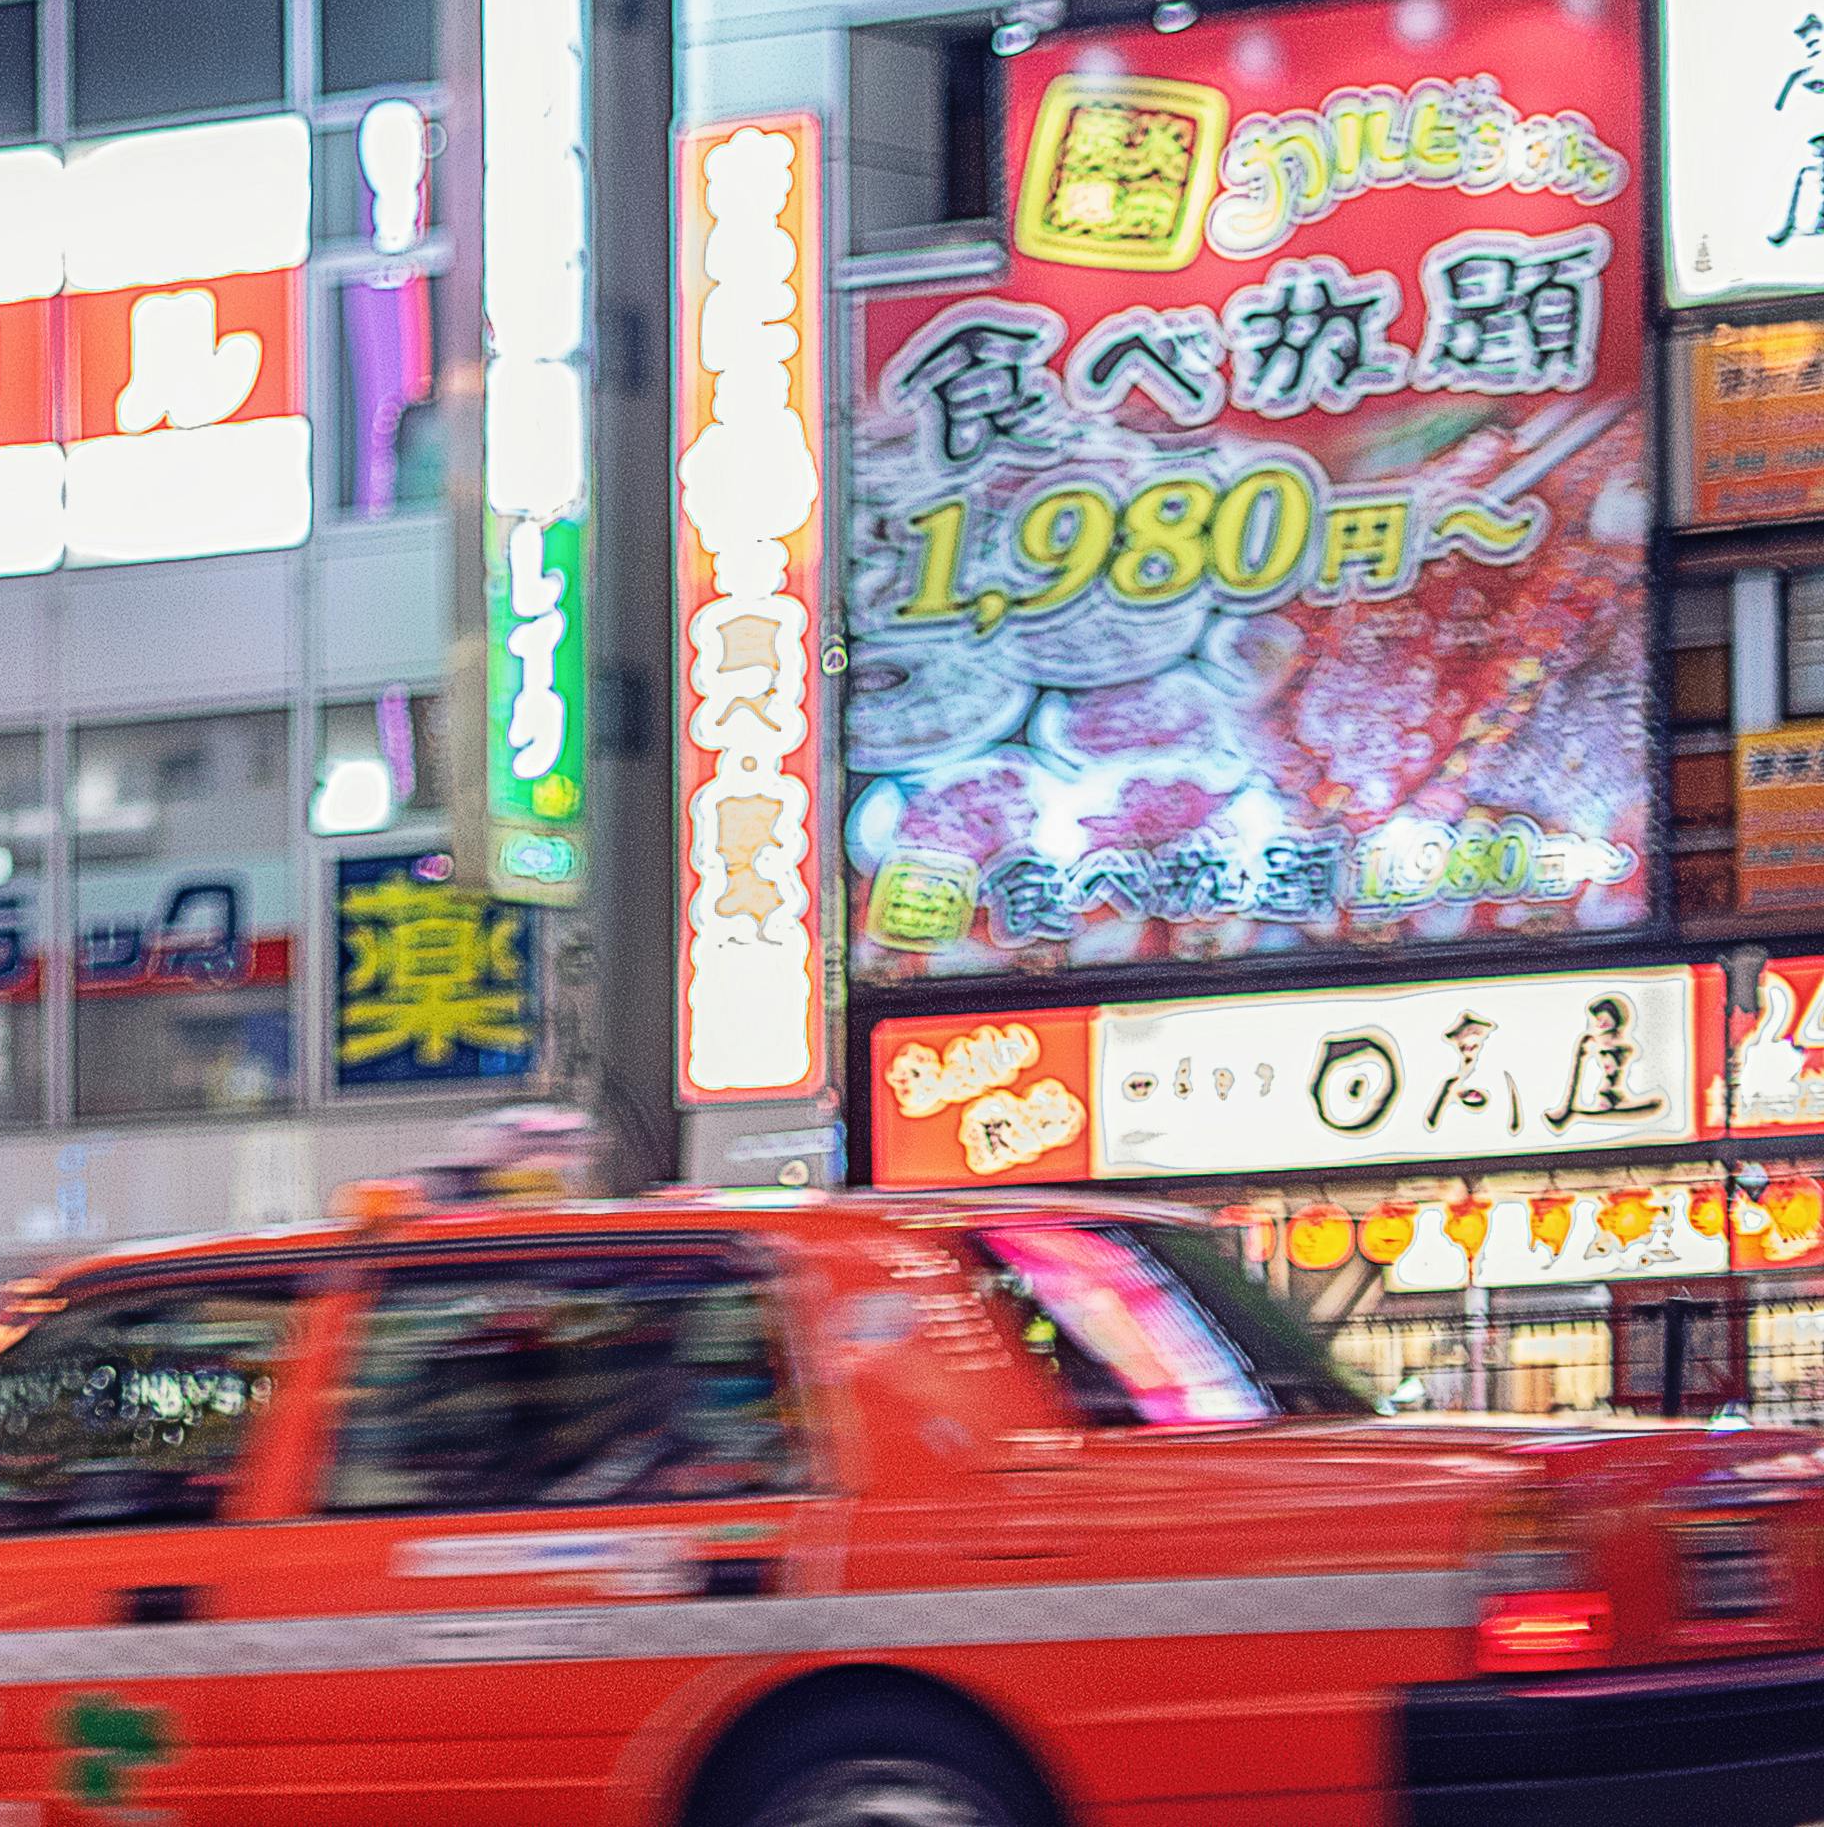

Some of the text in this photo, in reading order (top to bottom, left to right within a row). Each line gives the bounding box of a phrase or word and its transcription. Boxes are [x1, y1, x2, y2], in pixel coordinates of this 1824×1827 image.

[887, 229, 1610, 464] 食べ放題
[337, 871, 534, 1069] 薬
[1309, 994, 1664, 1137] 日高屋
